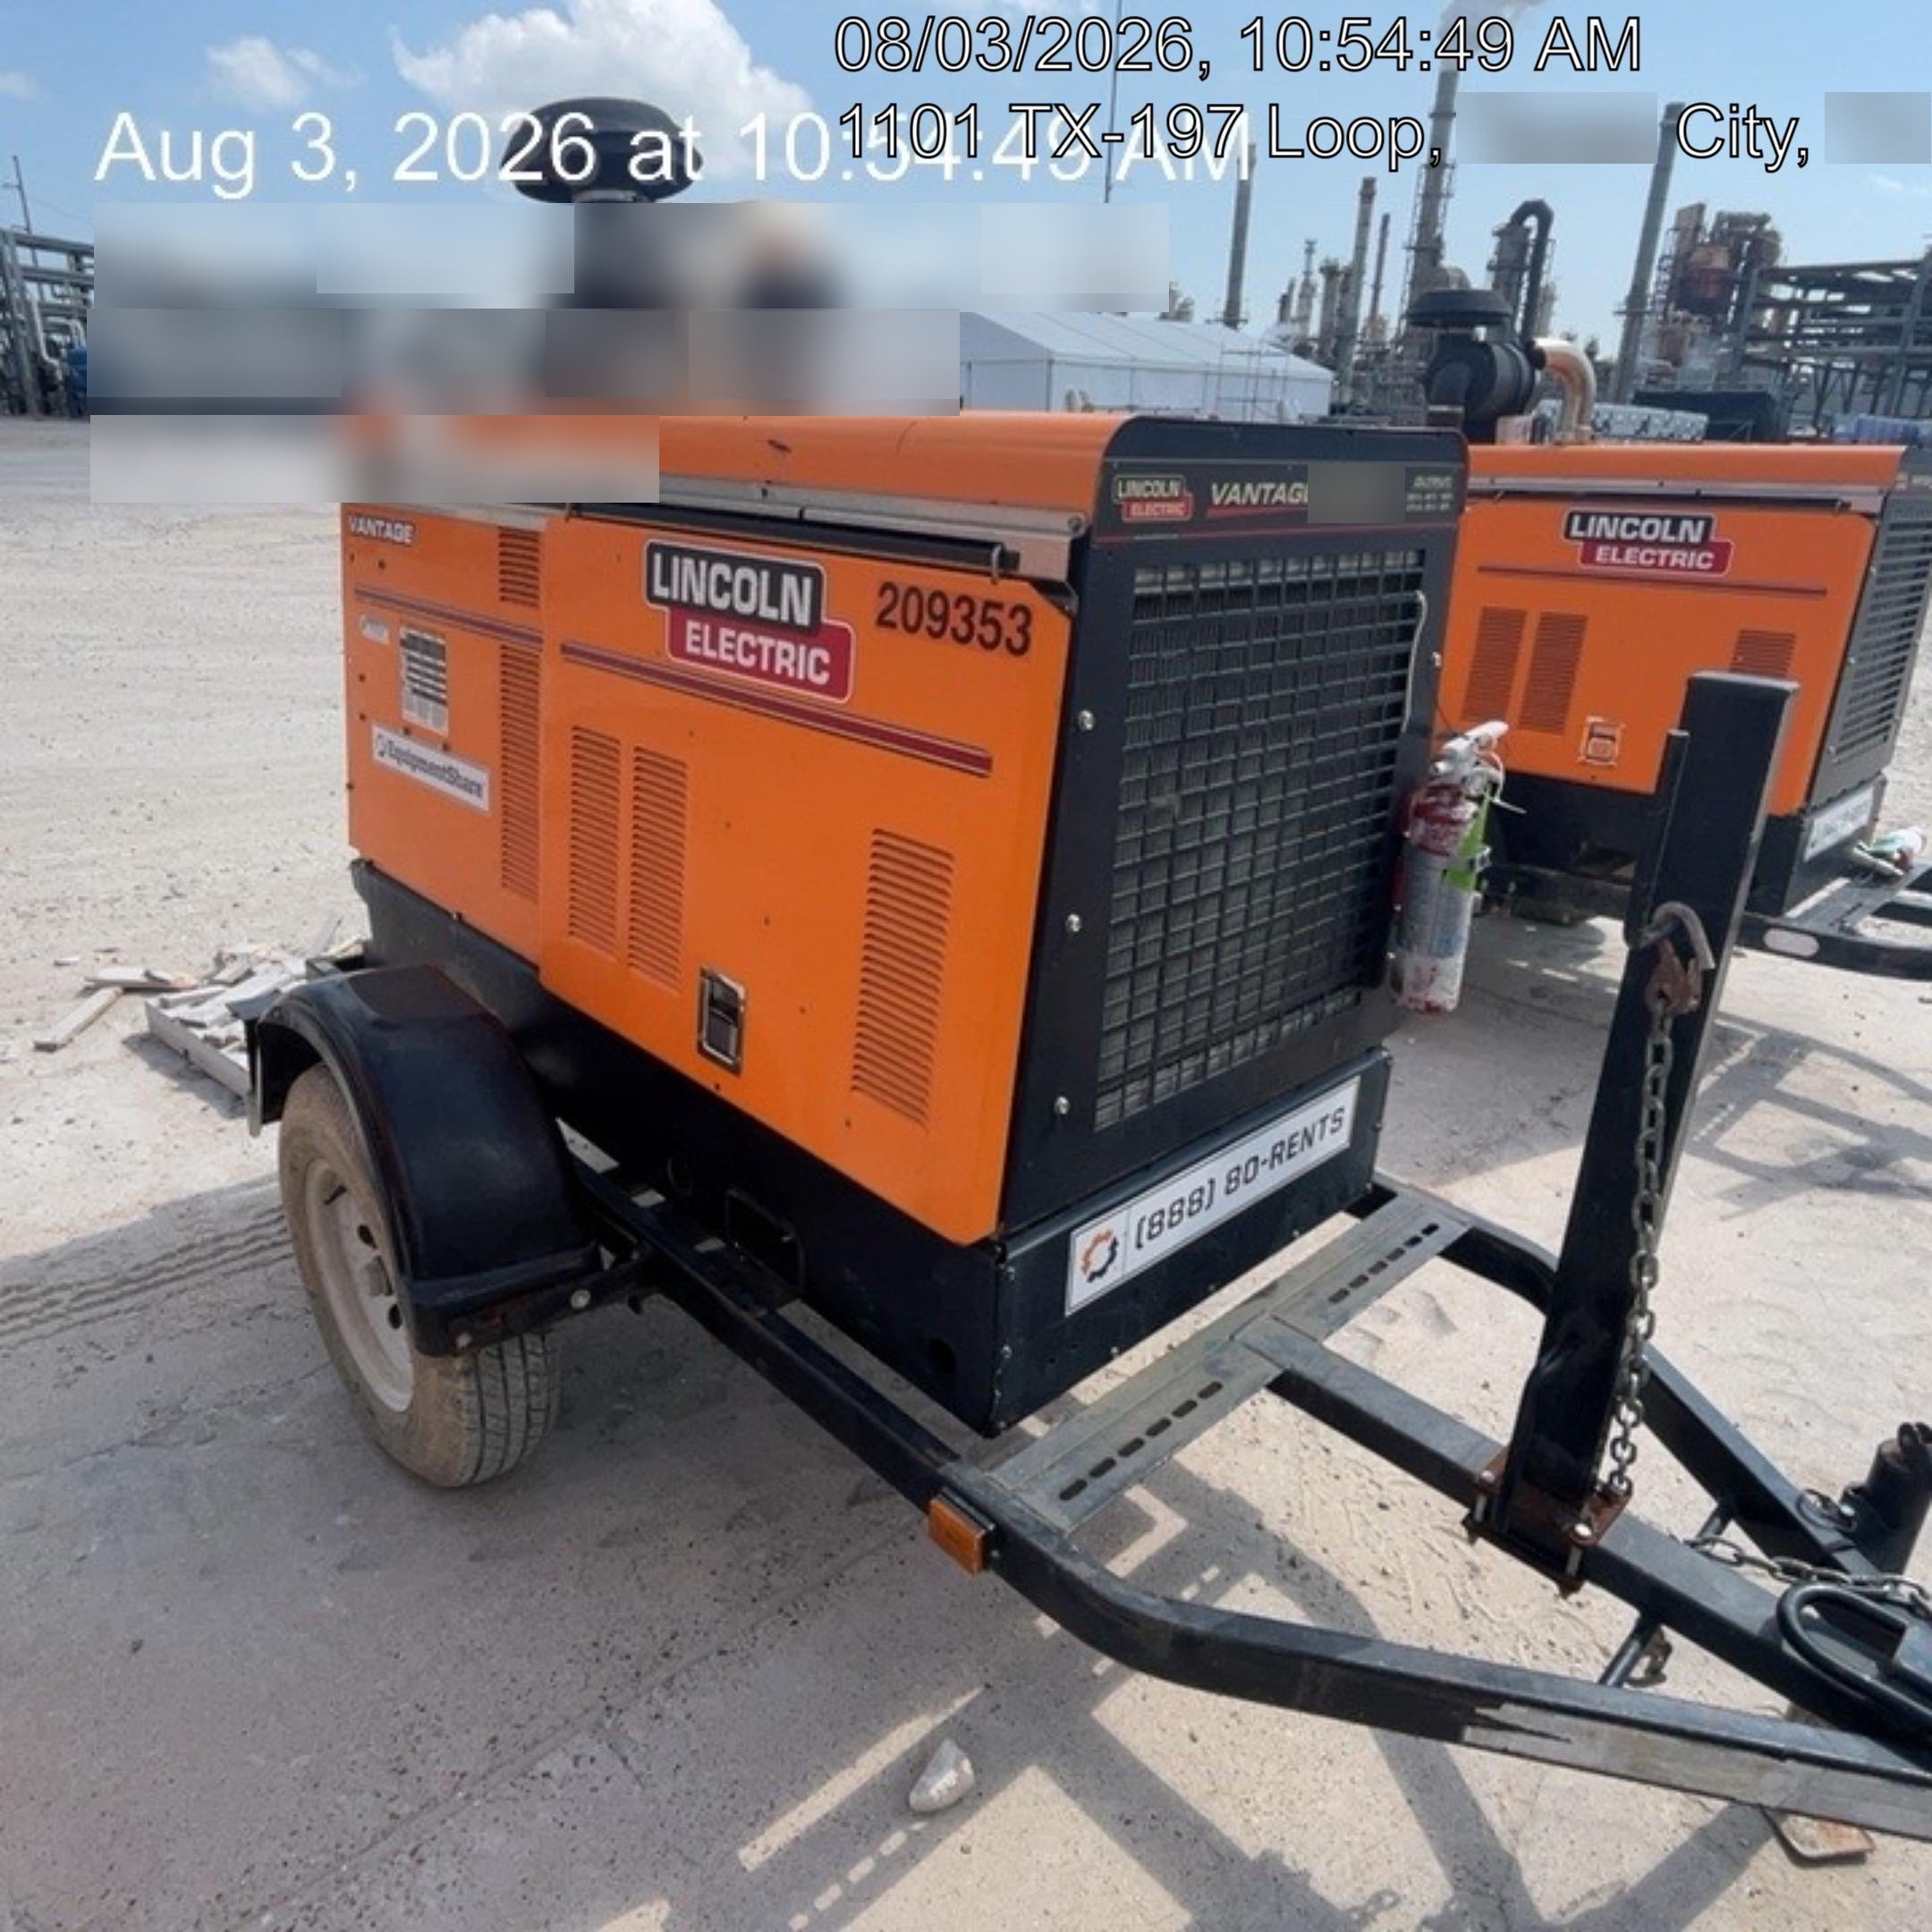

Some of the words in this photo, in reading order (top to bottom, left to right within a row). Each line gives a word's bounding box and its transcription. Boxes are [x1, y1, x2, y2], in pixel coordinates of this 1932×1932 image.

[1211, 481, 1308, 506] VANTAG
[349, 514, 413, 545] VANTAGE
[1570, 514, 1705, 543] LINCOLN
[1596, 545, 1716, 570] ELECTRIC
[652, 552, 813, 626] LINCOLN
[876, 581, 1034, 657] 209353
[685, 619, 831, 686] ELECTRIC
[1135, 1179, 1215, 1249] (888)
[1224, 1108, 1344, 1195] 80-RENTS
